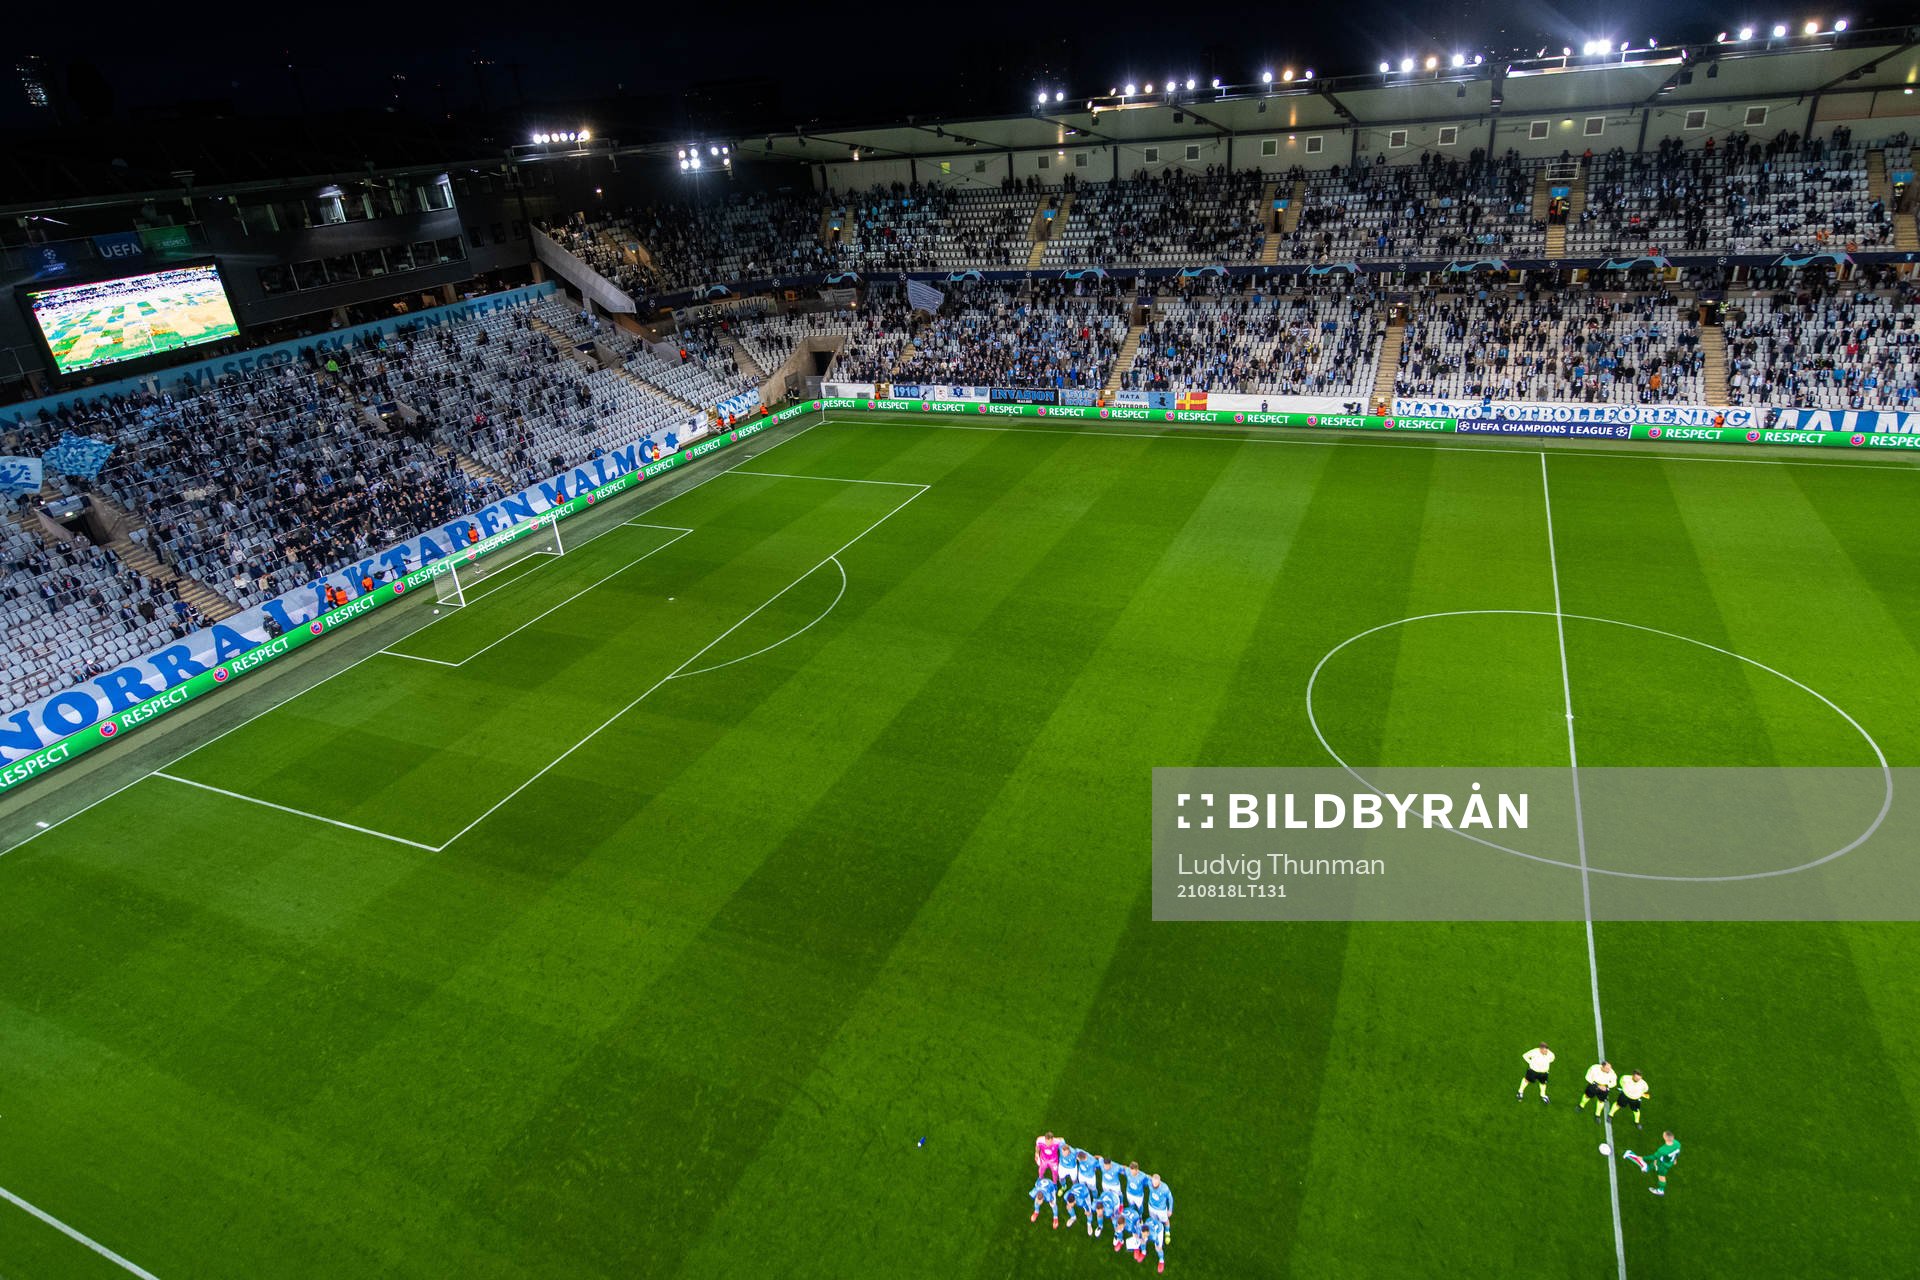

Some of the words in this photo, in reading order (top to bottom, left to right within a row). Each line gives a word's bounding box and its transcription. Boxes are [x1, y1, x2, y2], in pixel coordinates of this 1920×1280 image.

[98, 243, 142, 259] UEFA
[991, 388, 1055, 401] INVASION
[823, 399, 856, 409] RESPECT
[877, 401, 910, 411] RESPECT
[931, 402, 966, 413] RESPECT
[989, 404, 1024, 415] RESPECT
[779, 405, 803, 421] RESPECT
[1048, 406, 1086, 417] RESPECT
[1112, 409, 1150, 420] RESPECT
[1177, 411, 1218, 422] RESPECT
[1397, 400, 1485, 420] MALMÖ
[1488, 403, 1748, 426] FOTBOLLFÖRENING
[1246, 413, 1290, 424] RESPECT
[1320, 415, 1366, 427] RESPECT
[1398, 418, 1447, 430] RESPECT
[739, 421, 764, 439] RESPECT
[1472, 422, 1500, 432] UEFA
[1502, 423, 1567, 434] CHAMPIONS
[1569, 425, 1613, 435] LEAGUE
[1665, 428, 1723, 440] RESPECT
[1764, 431, 1826, 444] RESPECT
[694, 438, 721, 457] RESPECT
[645, 458, 676, 478] RESPECT
[596, 478, 627, 500] RESPECT
[407, 560, 452, 588] RESPECT
[0, 625, 262, 766] NORRA
[262, 491, 538, 632] LÄKTAREN
[539, 434, 657, 509] MALMÖ
[326, 594, 375, 628] RESPECT
[231, 636, 290, 675] RESPECT
[121, 685, 188, 728] RESPECT
